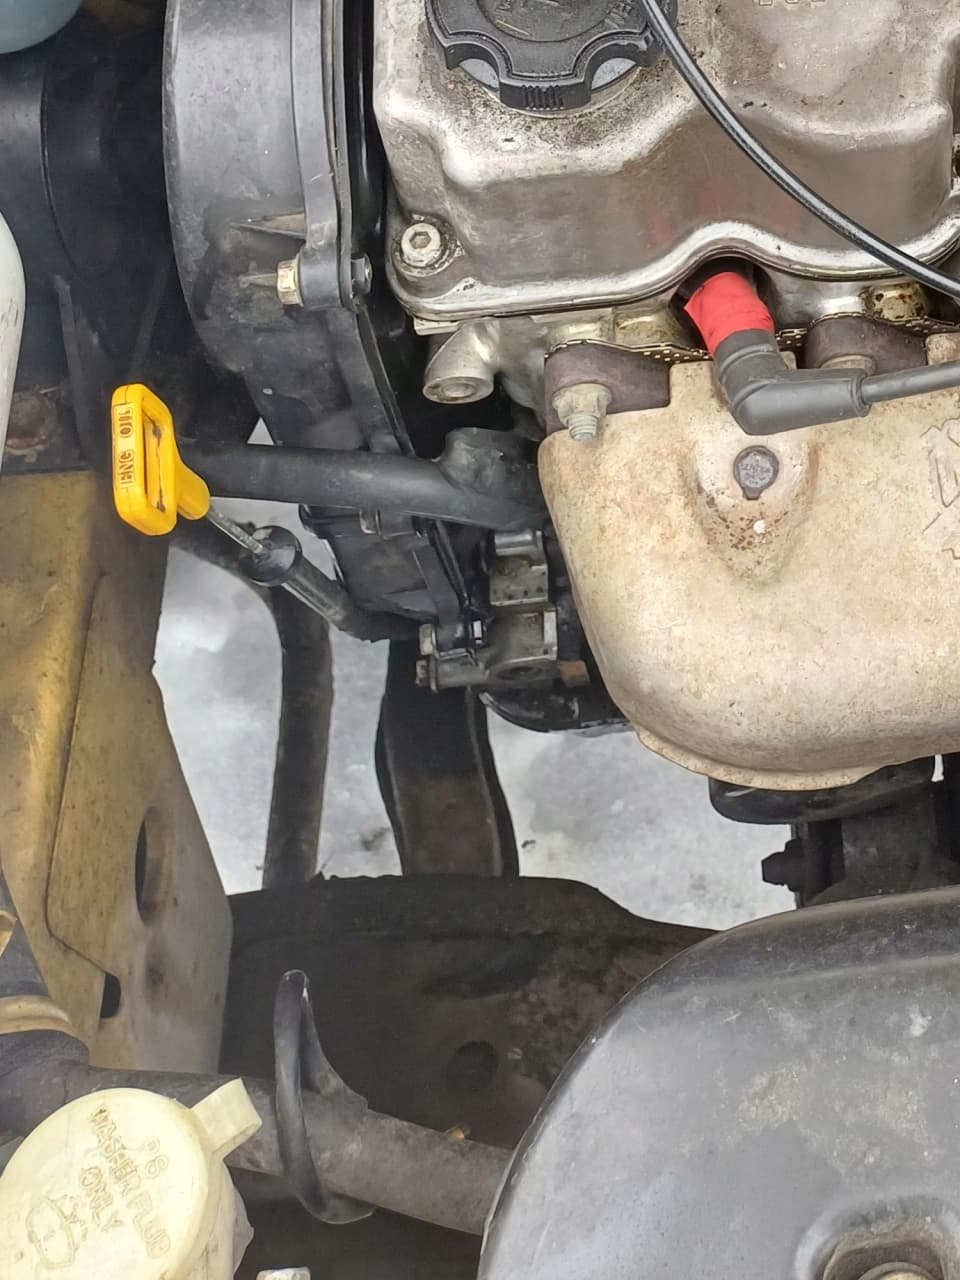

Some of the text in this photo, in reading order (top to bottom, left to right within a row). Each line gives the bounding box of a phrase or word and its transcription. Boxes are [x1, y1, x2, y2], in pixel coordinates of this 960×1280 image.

[117, 406, 136, 486] ENG OIL
[90, 1105, 142, 1198] WASHER
[79, 1166, 125, 1232] ONLY
